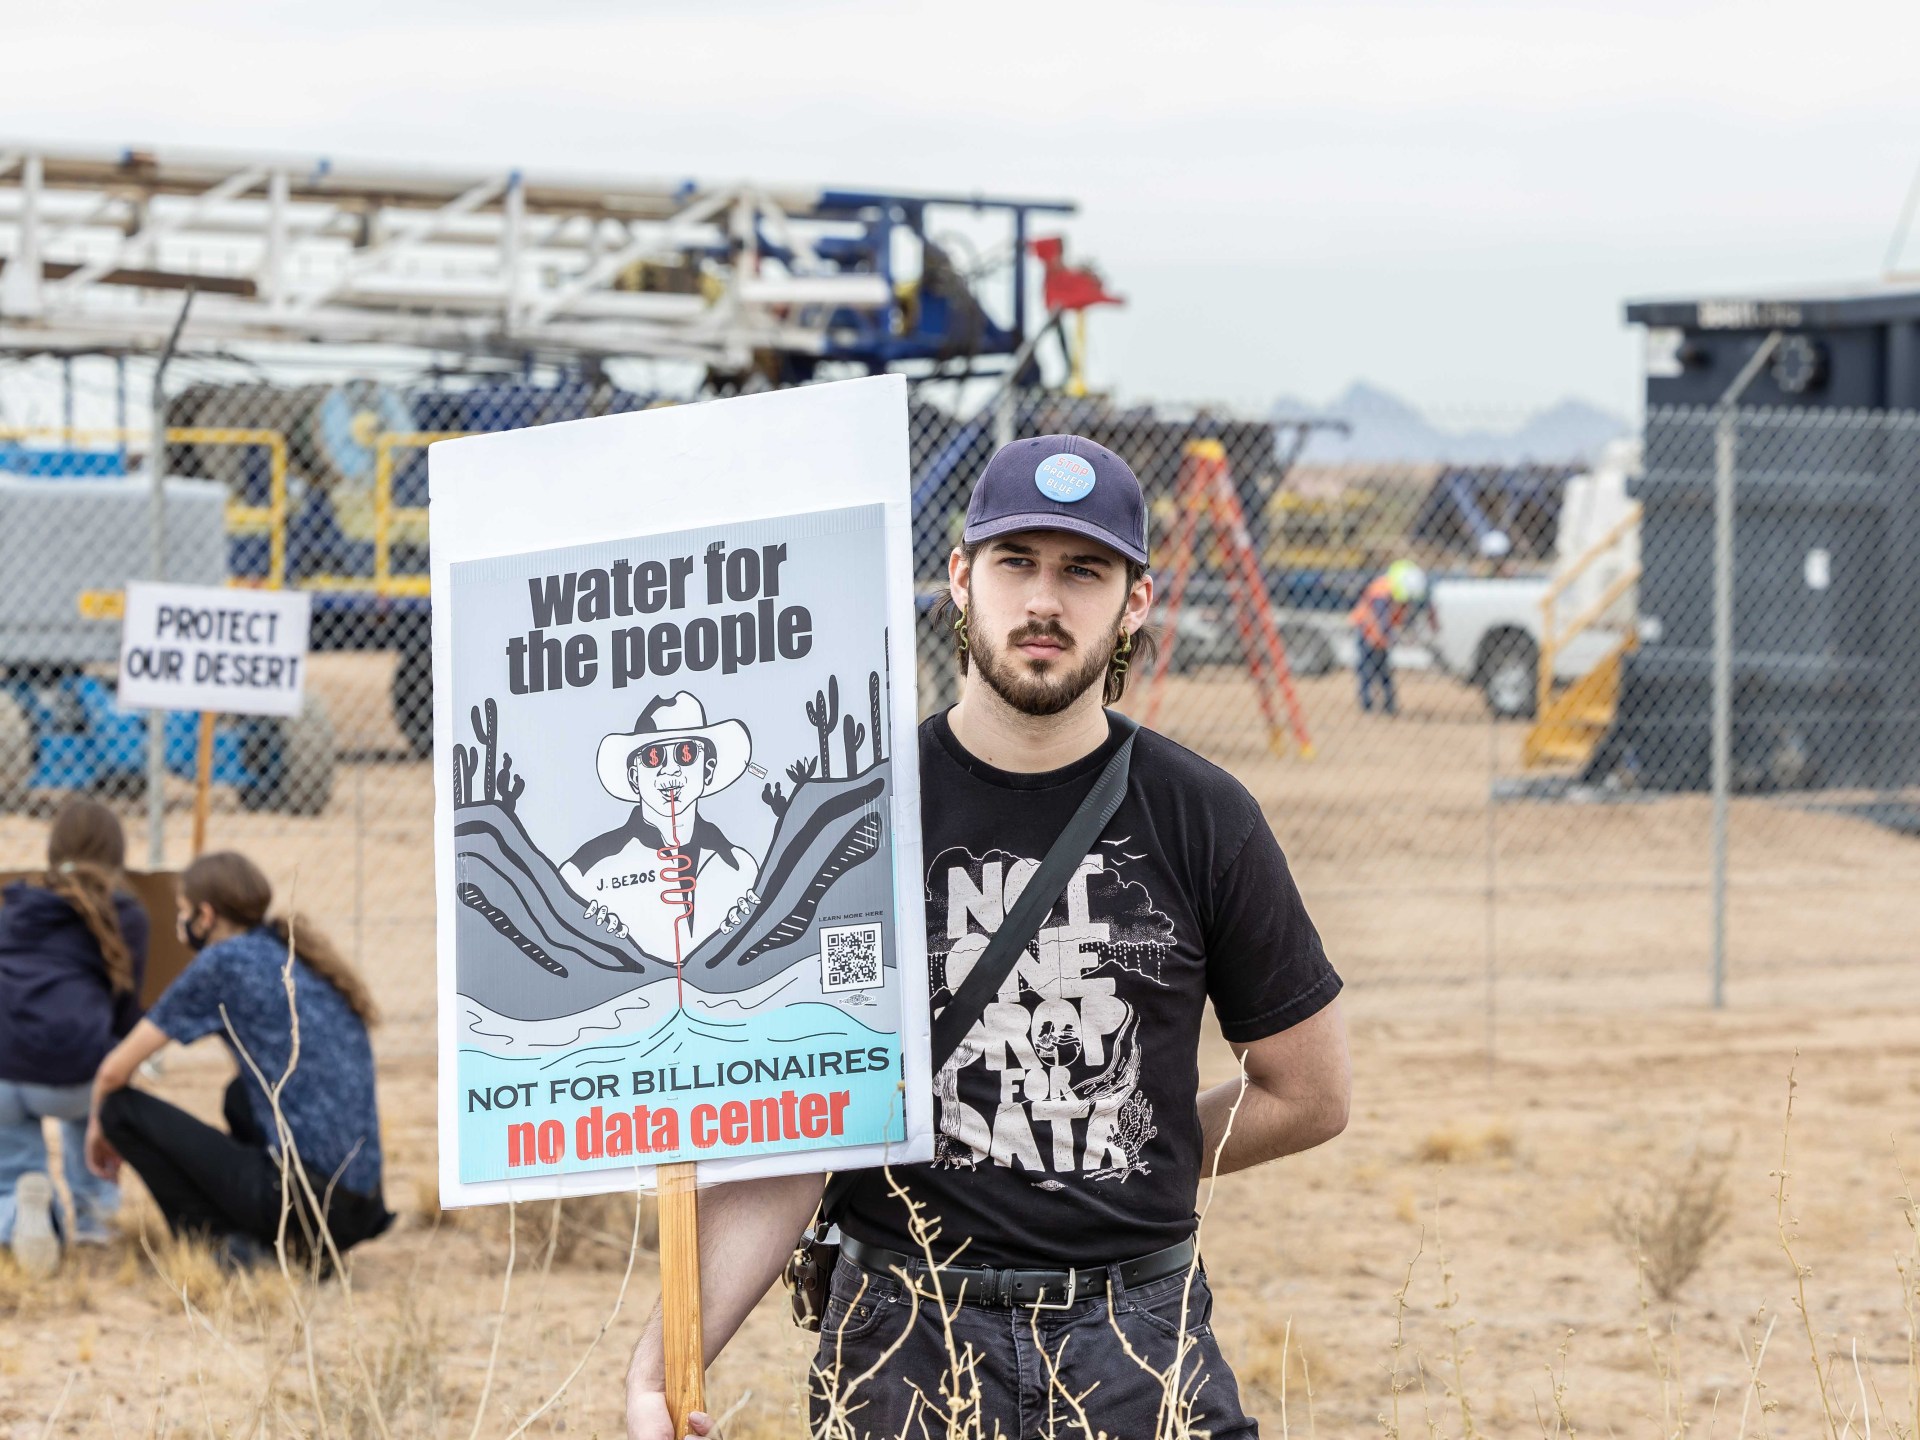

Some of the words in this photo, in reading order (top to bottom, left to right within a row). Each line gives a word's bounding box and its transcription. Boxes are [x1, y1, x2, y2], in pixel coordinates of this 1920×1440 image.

[1043, 464, 1090, 490] PROJECT
[1046, 478, 1073, 495] BLUE
[1057, 457, 1089, 476] STOP
[528, 555, 693, 629] water
[704, 540, 787, 605] for
[155, 605, 280, 645] PROTECT
[506, 630, 598, 695] the
[612, 599, 812, 689] people
[127, 647, 184, 681] OUR
[193, 652, 299, 689] DESERT
[596, 878, 609, 891] J.
[611, 869, 656, 889] BEZOS
[818, 914, 842, 923] LEARN
[843, 912, 863, 920] MORE
[467, 1082, 538, 1113] NOT
[549, 1074, 620, 1104] FOR
[632, 1047, 890, 1096] BILLIONAIRES
[1000, 1066, 1079, 1104] FOR
[507, 1118, 566, 1168] no
[575, 1105, 680, 1161] data
[690, 1088, 851, 1149] center
[940, 1098, 1129, 1173] DATA
